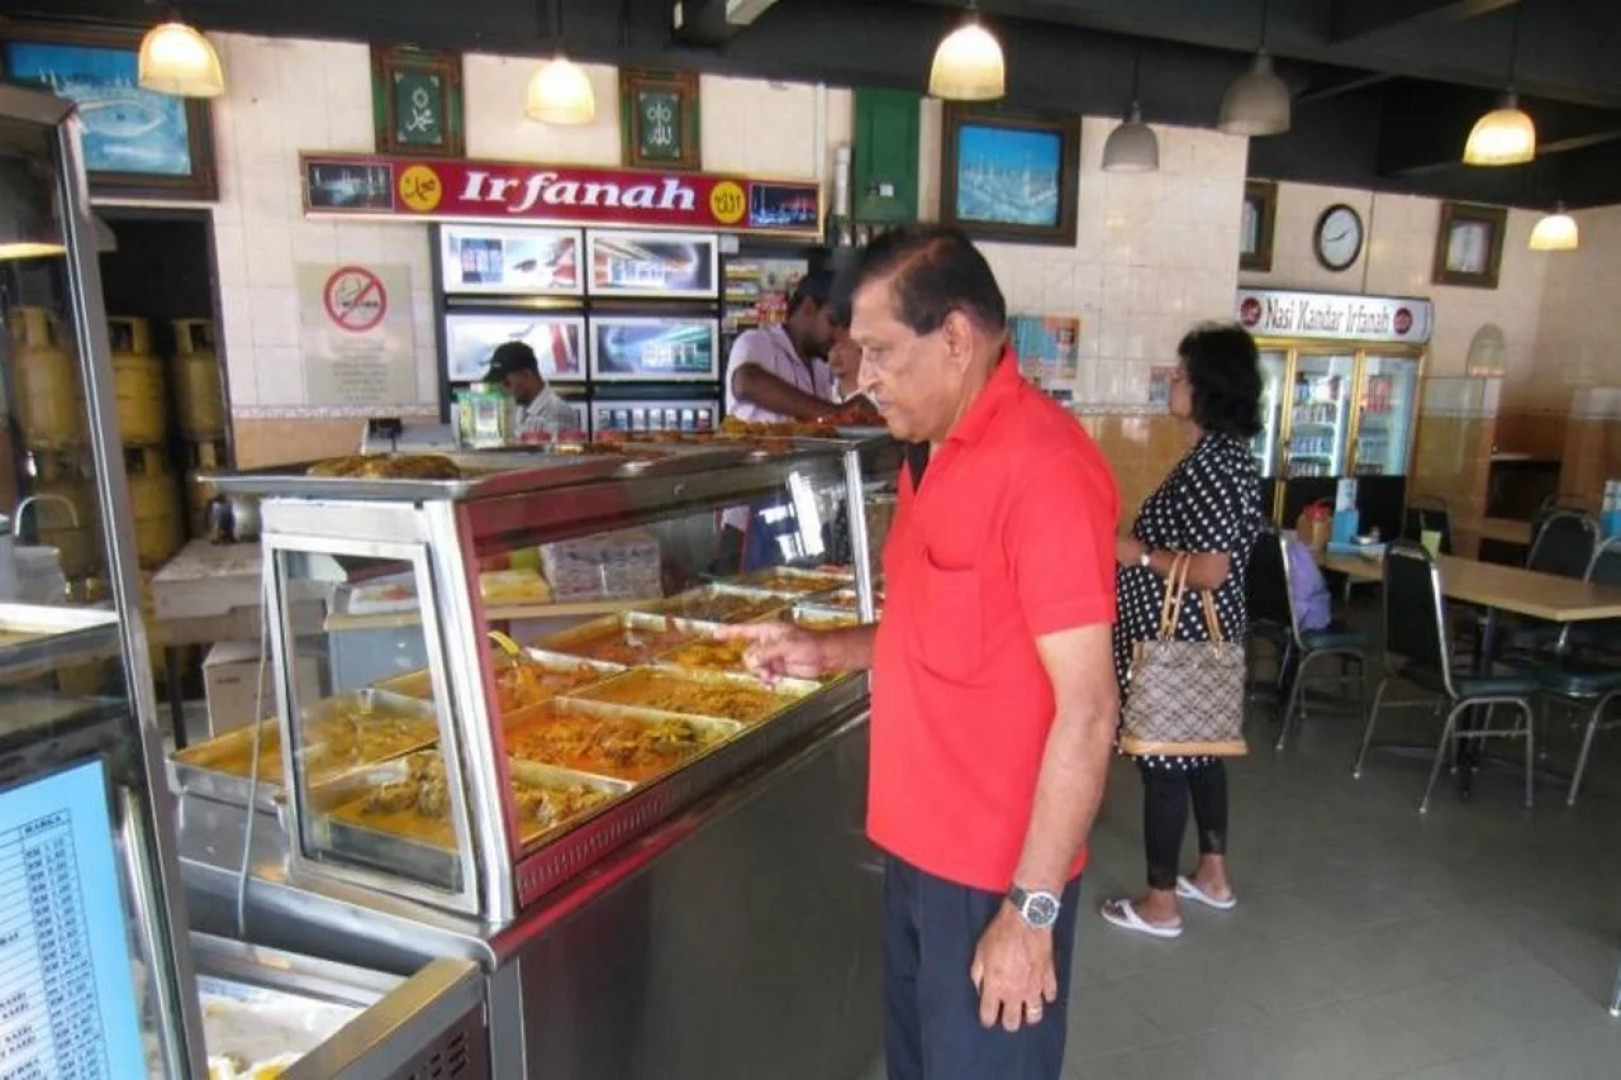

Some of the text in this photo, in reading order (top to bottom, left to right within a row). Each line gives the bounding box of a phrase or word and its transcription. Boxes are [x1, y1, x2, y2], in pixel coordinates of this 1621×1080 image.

[459, 171, 694, 212] Irfanah
[1266, 297, 1294, 329] Nasi
[1297, 299, 1345, 331] Kandar
